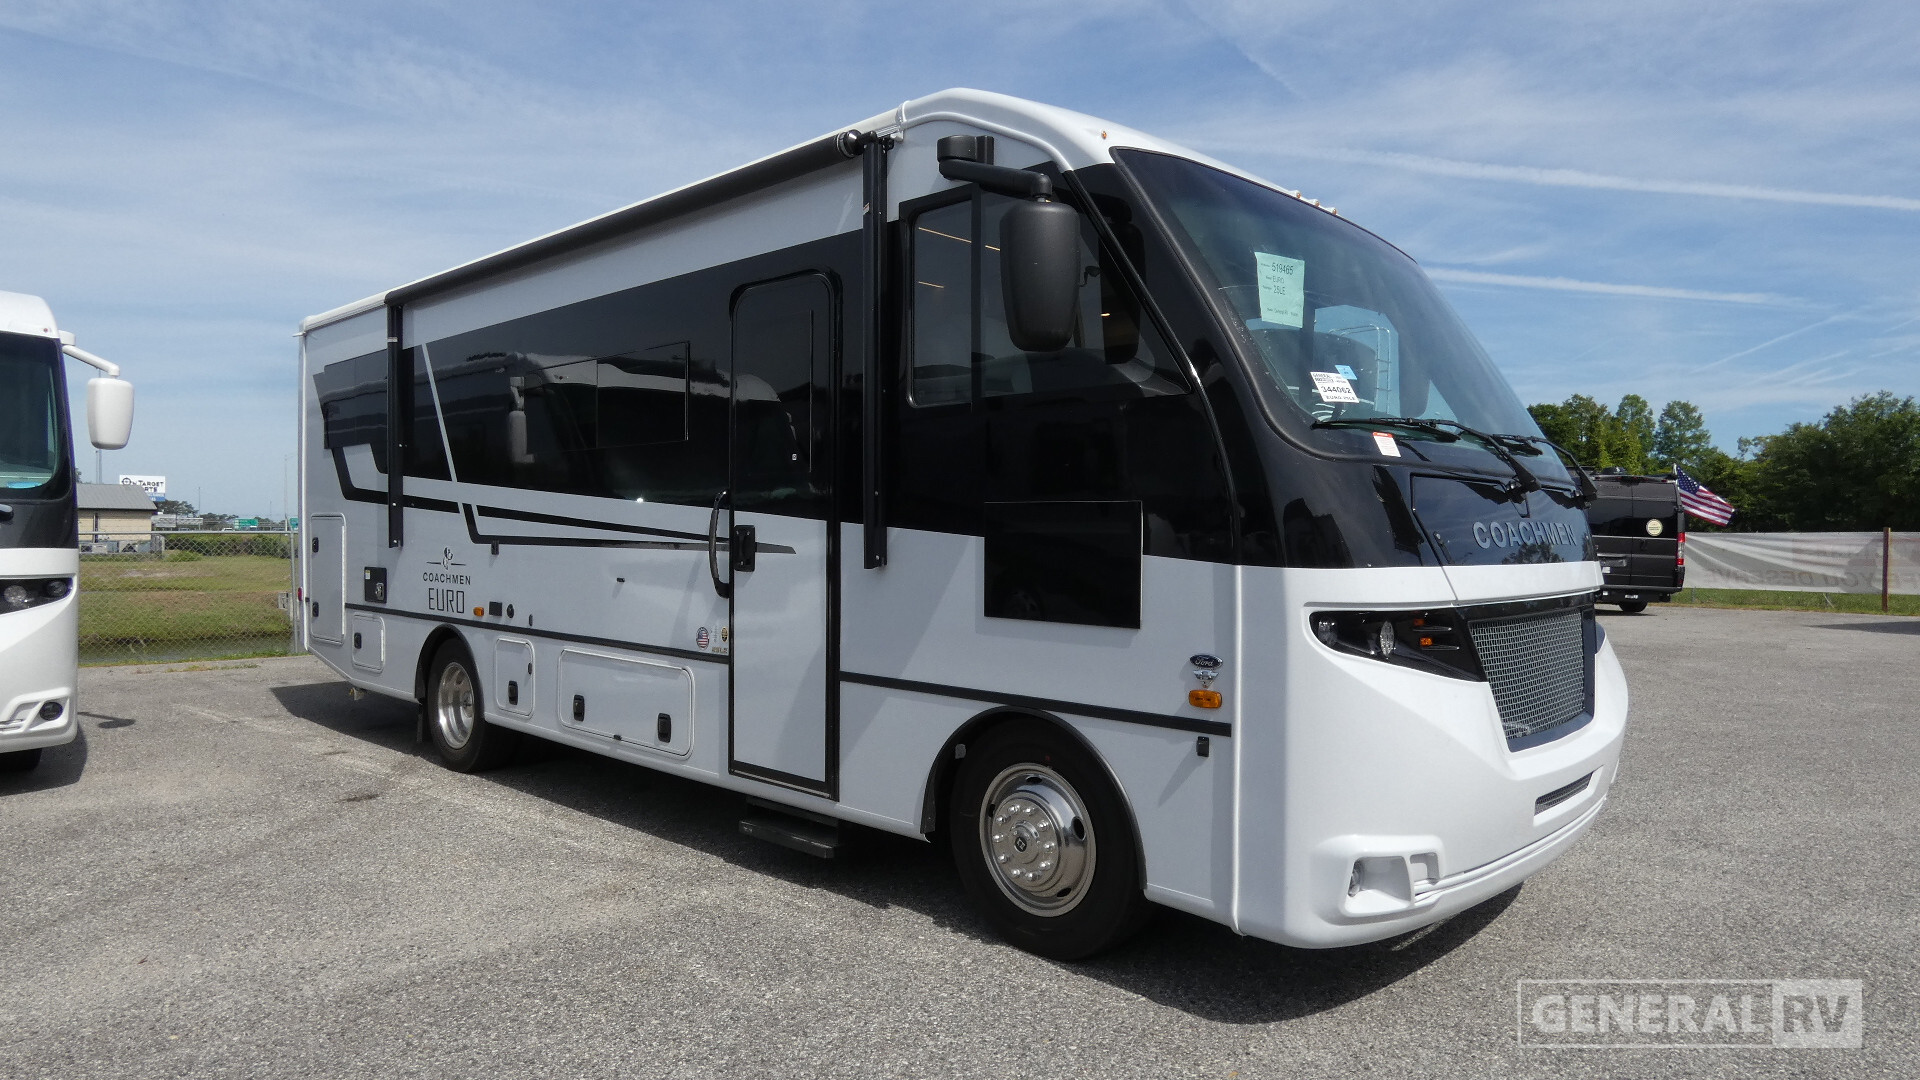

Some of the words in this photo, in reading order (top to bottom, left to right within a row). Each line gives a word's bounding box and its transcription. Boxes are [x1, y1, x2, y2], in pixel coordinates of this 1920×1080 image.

[1271, 262, 1294, 275] 519465
[1472, 521, 1577, 549] COACHMEN
[422, 572, 471, 585] COACHMEN
[428, 588, 465, 614] EURO
